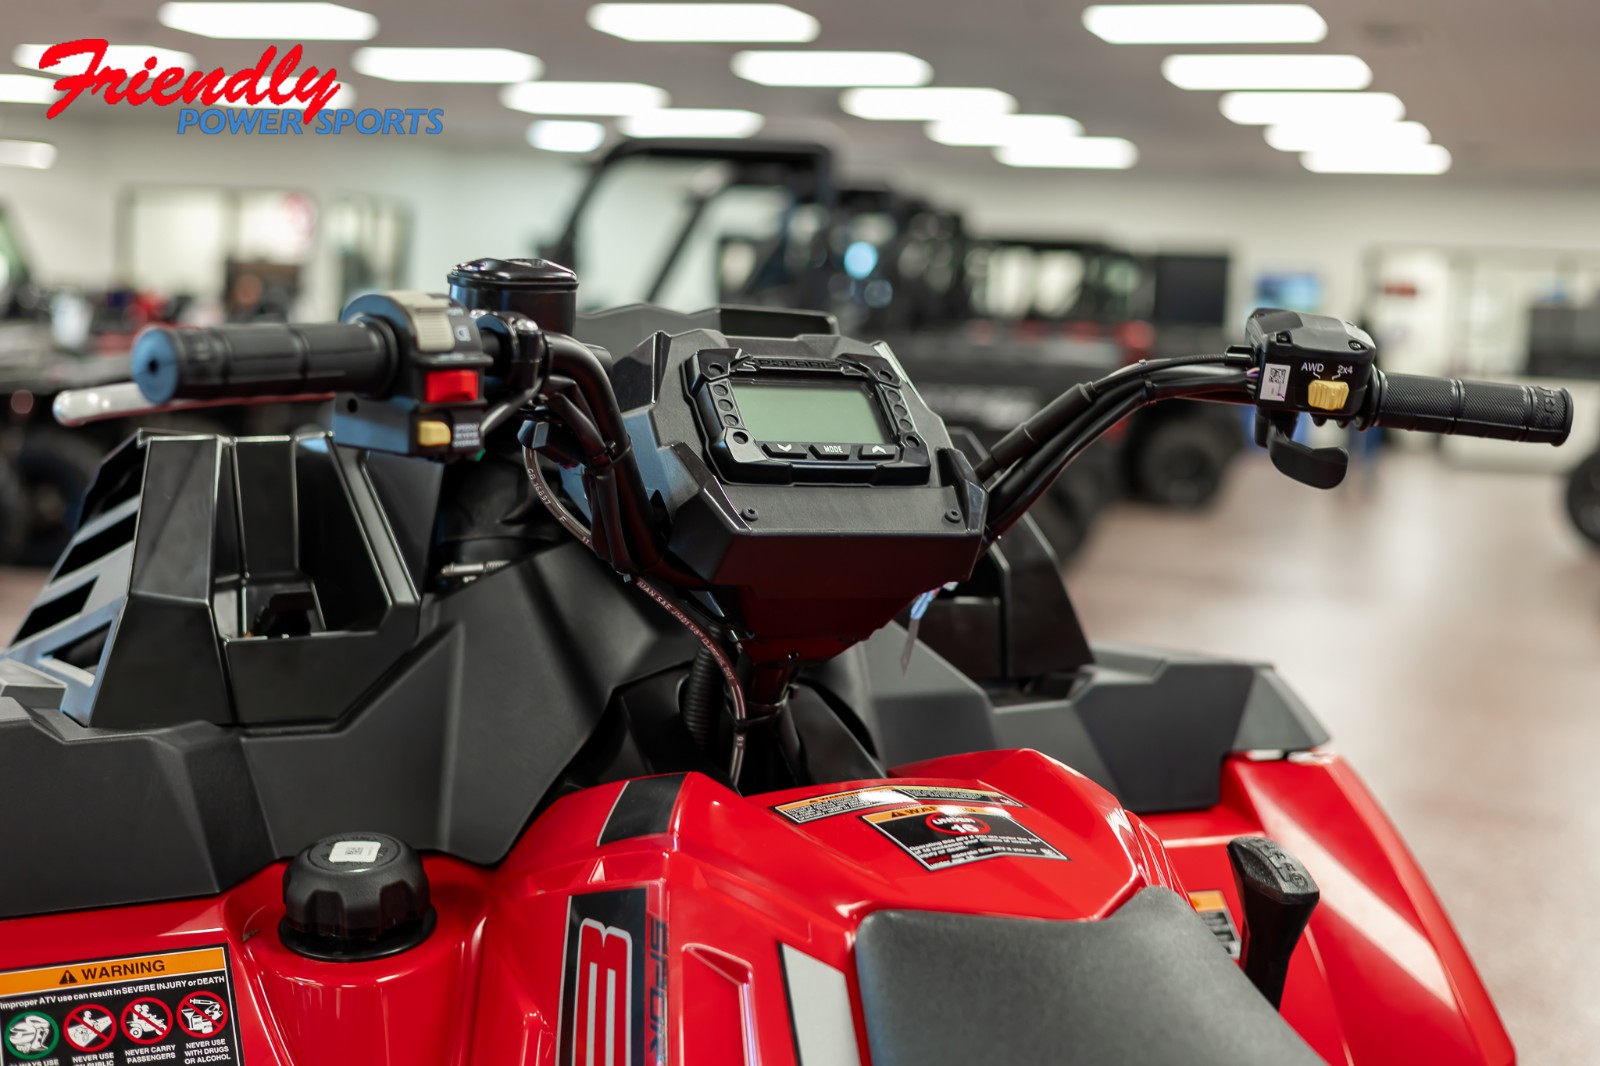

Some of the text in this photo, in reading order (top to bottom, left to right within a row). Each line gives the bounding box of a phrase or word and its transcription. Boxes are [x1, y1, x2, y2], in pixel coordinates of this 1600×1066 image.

[1301, 362, 1325, 372] AWD
[1337, 365, 1353, 374] 2x4
[823, 445, 843, 454] MODE
[656, 596, 673, 610] SAE
[951, 823, 979, 833] 16
[81, 960, 166, 980] WARNING
[0, 998, 38, 1010] Improper
[39, 995, 56, 1005] ATV
[57, 994, 72, 1002] use
[74, 992, 88, 1000] can
[89, 989, 113, 999] result
[122, 983, 156, 994] SEVERE
[156, 980, 187, 990] INJURY
[187, 978, 197, 987] or
[197, 975, 225, 985] DEATH
[185, 1038, 226, 1049] NEVER USE
[125, 1044, 176, 1056] NEVER CARRY
[184, 1046, 229, 1057] WITH DRUGS
[72, 1052, 114, 1063] NEVER USE
[126, 1052, 176, 1064] PASSENGERS
[184, 1054, 231, 1065] OR ALCOHOL
